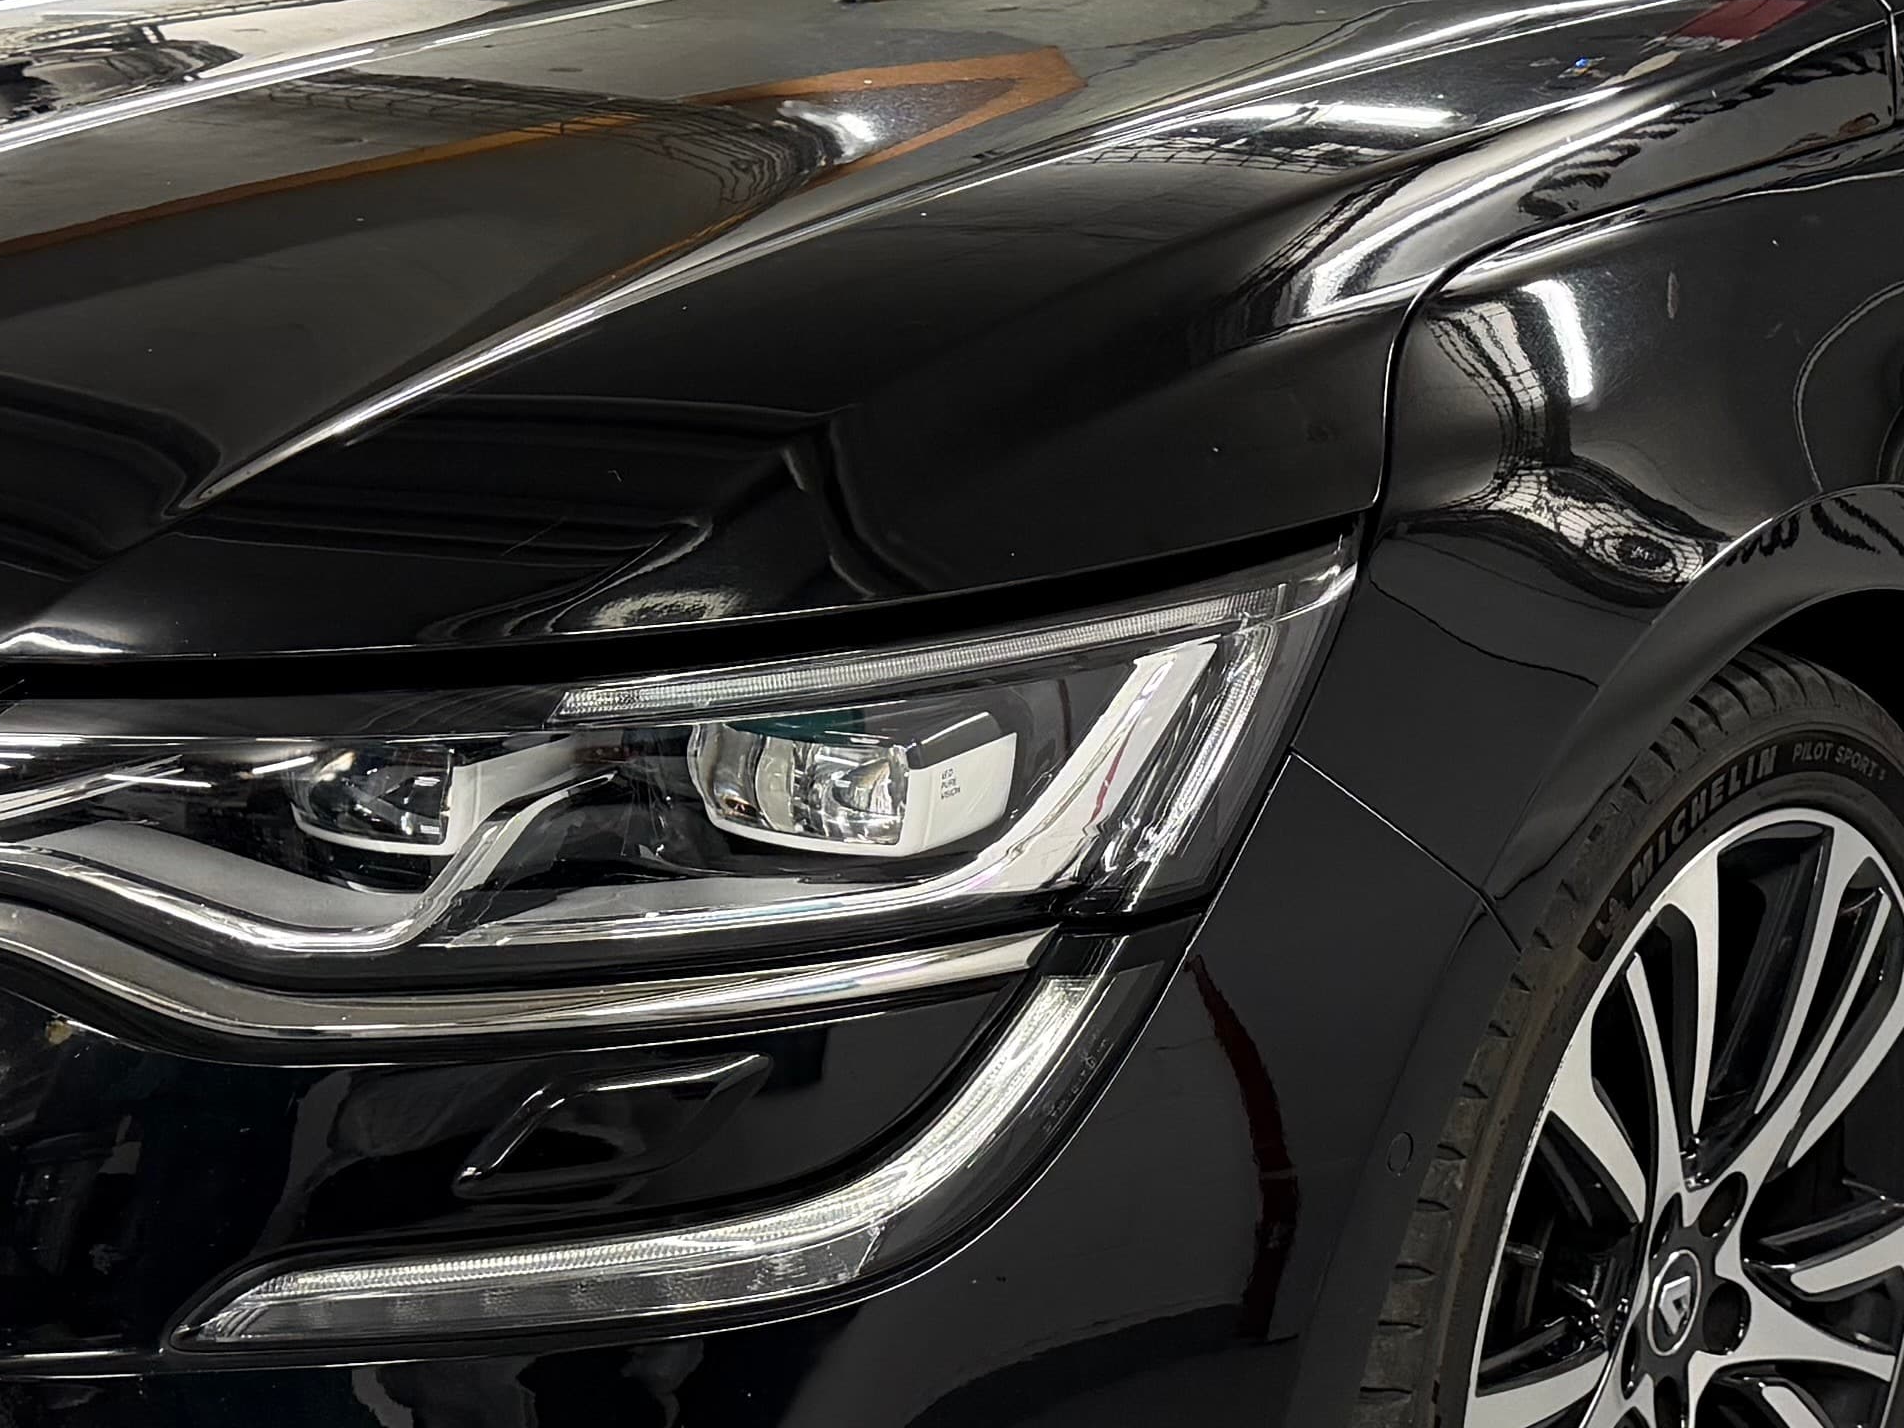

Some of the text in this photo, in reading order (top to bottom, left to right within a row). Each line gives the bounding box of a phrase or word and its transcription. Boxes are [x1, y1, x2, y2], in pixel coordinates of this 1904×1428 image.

[1631, 744, 1778, 898] MICHELIN
[1792, 740, 1834, 763] PILOT
[1835, 745, 1878, 778] SPORT
